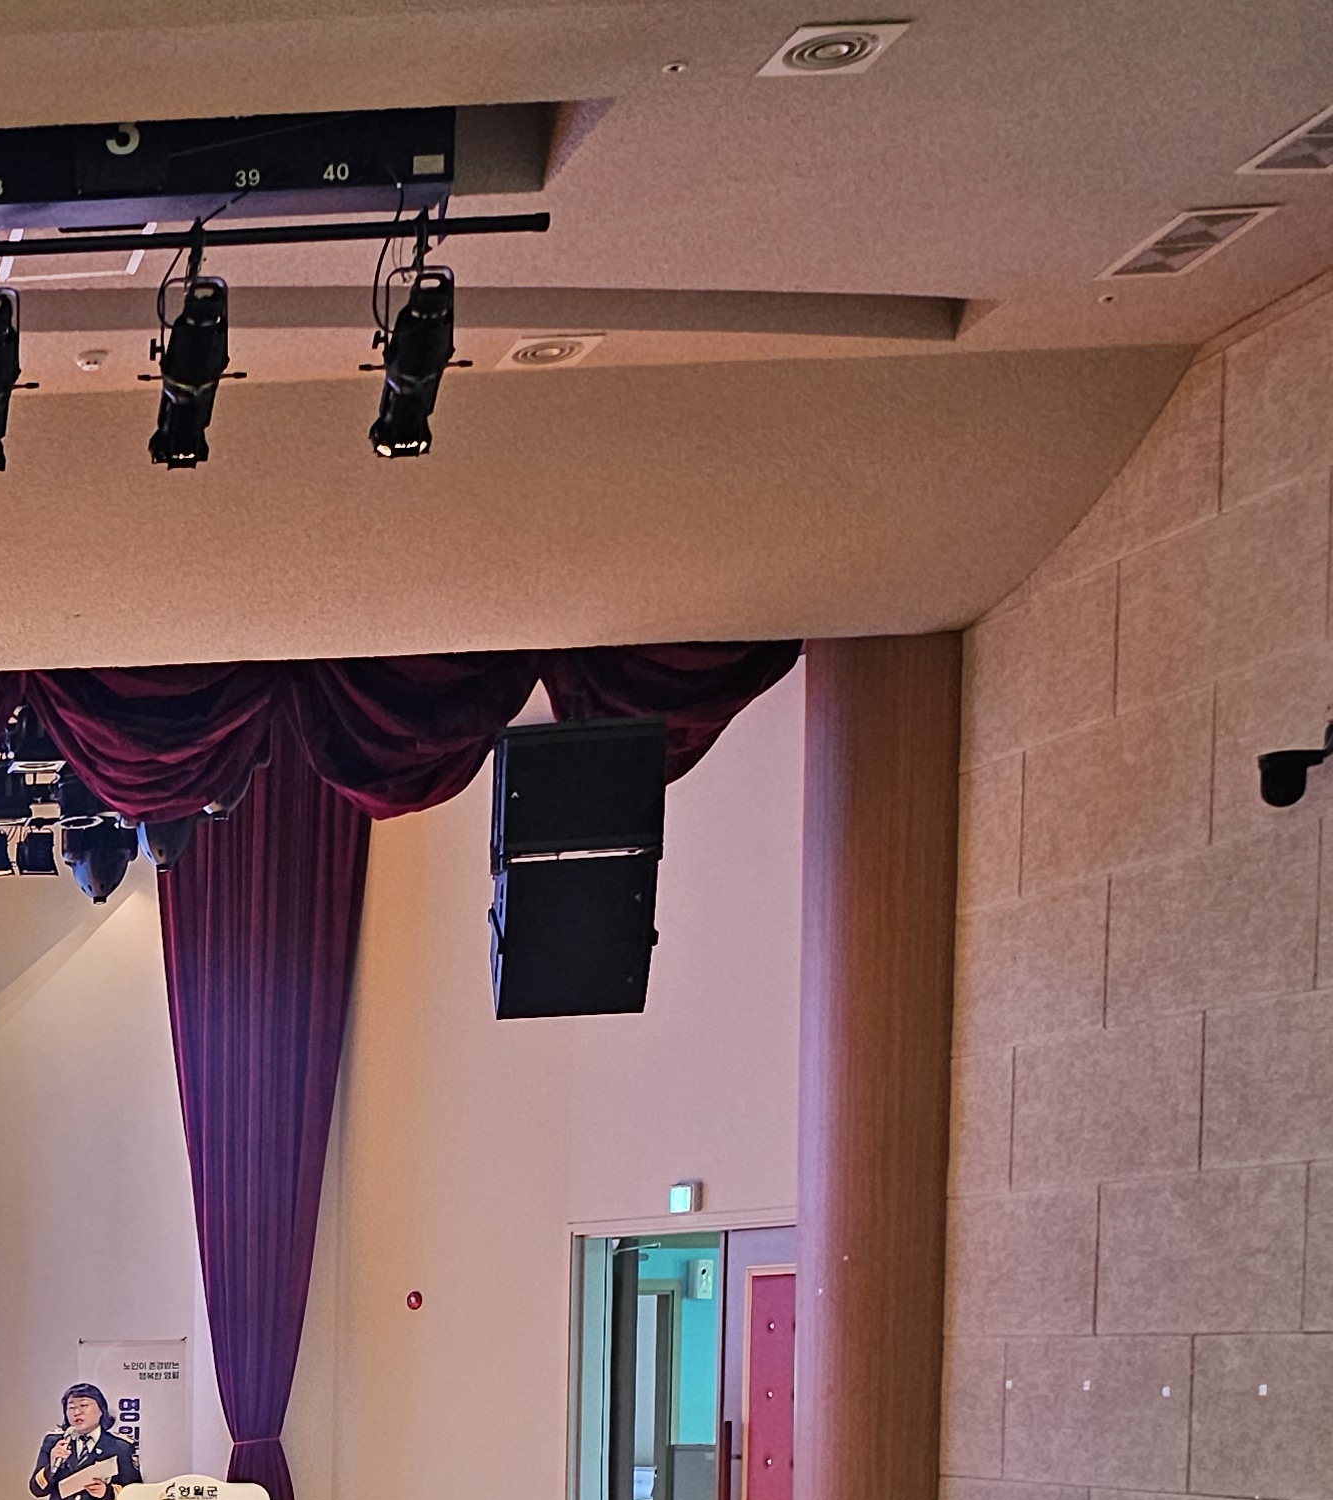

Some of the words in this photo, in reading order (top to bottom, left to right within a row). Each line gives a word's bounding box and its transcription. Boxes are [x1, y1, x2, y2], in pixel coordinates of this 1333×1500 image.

[235, 170, 261, 187] 39
[323, 164, 350, 181] 40
[178, 1485, 218, 1497] 영월군
